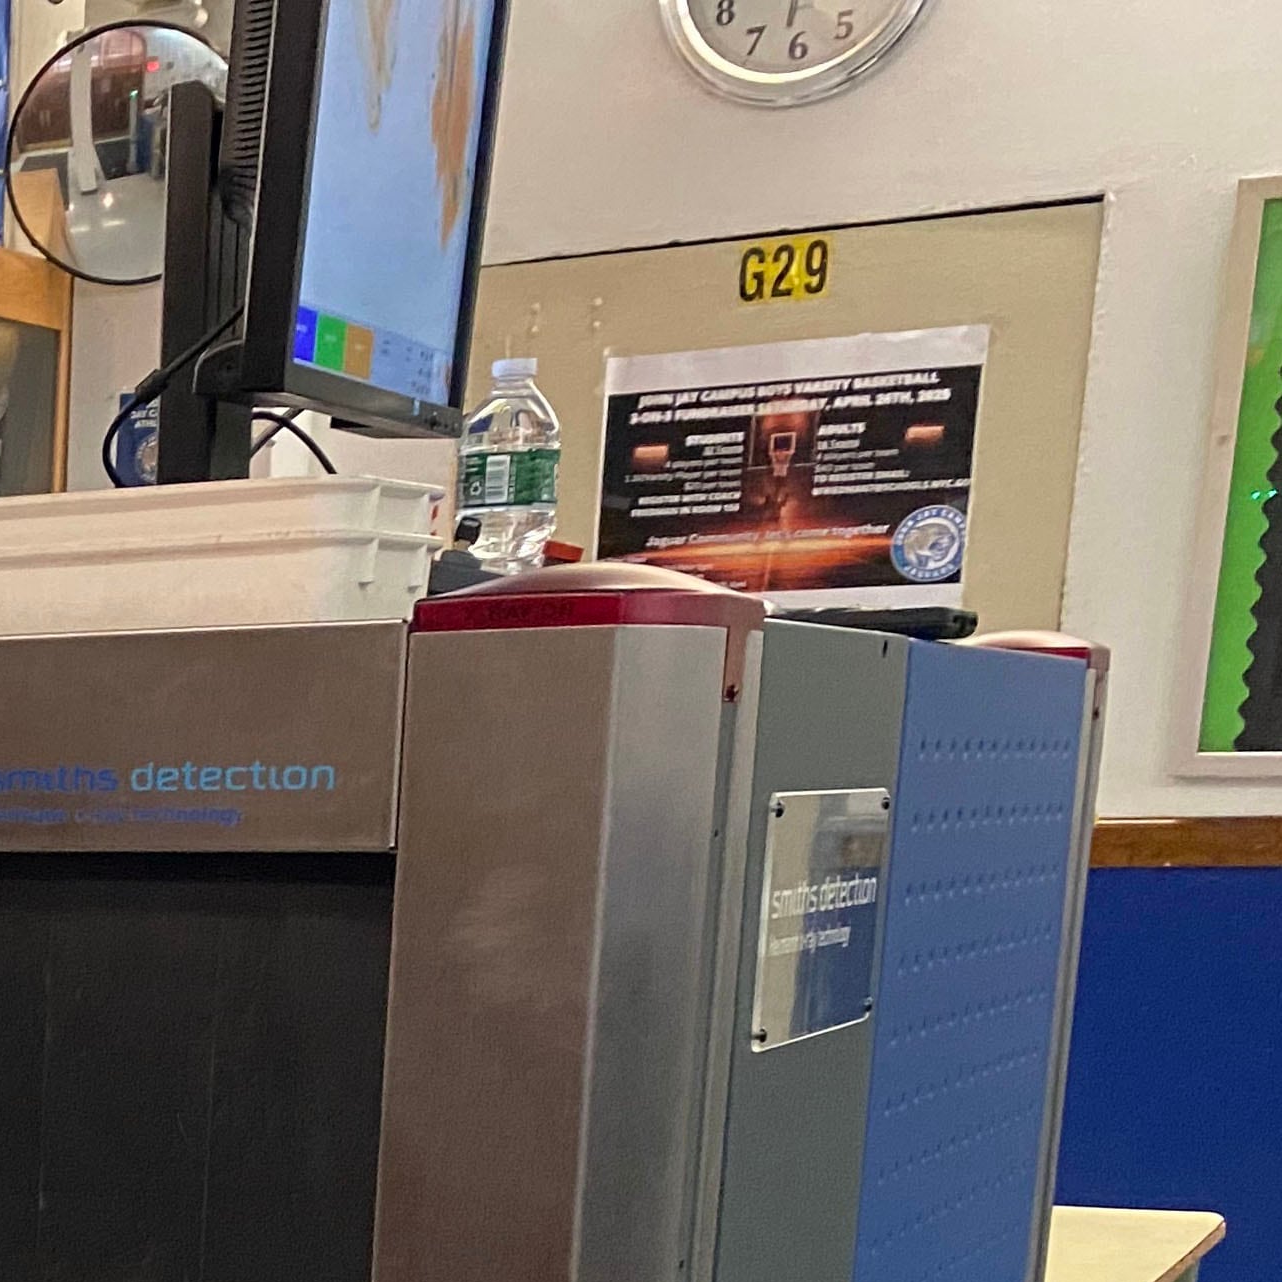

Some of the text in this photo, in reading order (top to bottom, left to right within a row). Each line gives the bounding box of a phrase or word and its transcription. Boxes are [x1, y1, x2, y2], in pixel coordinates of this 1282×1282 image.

[716, 0, 735, 26] 8
[834, 9, 854, 40] 5
[746, 24, 767, 56] 7
[788, 31, 809, 60] 6
[739, 239, 829, 302] G29
[675, 391, 699, 407] JAY
[699, 386, 756, 402] CAMPUS
[757, 383, 793, 398] BOYS
[794, 378, 852, 395] VARSITY
[852, 371, 942, 390] BASKETBALL
[833, 394, 873, 410] APRIL
[131, 761, 337, 792] detection
[771, 872, 877, 920] smiths detection
